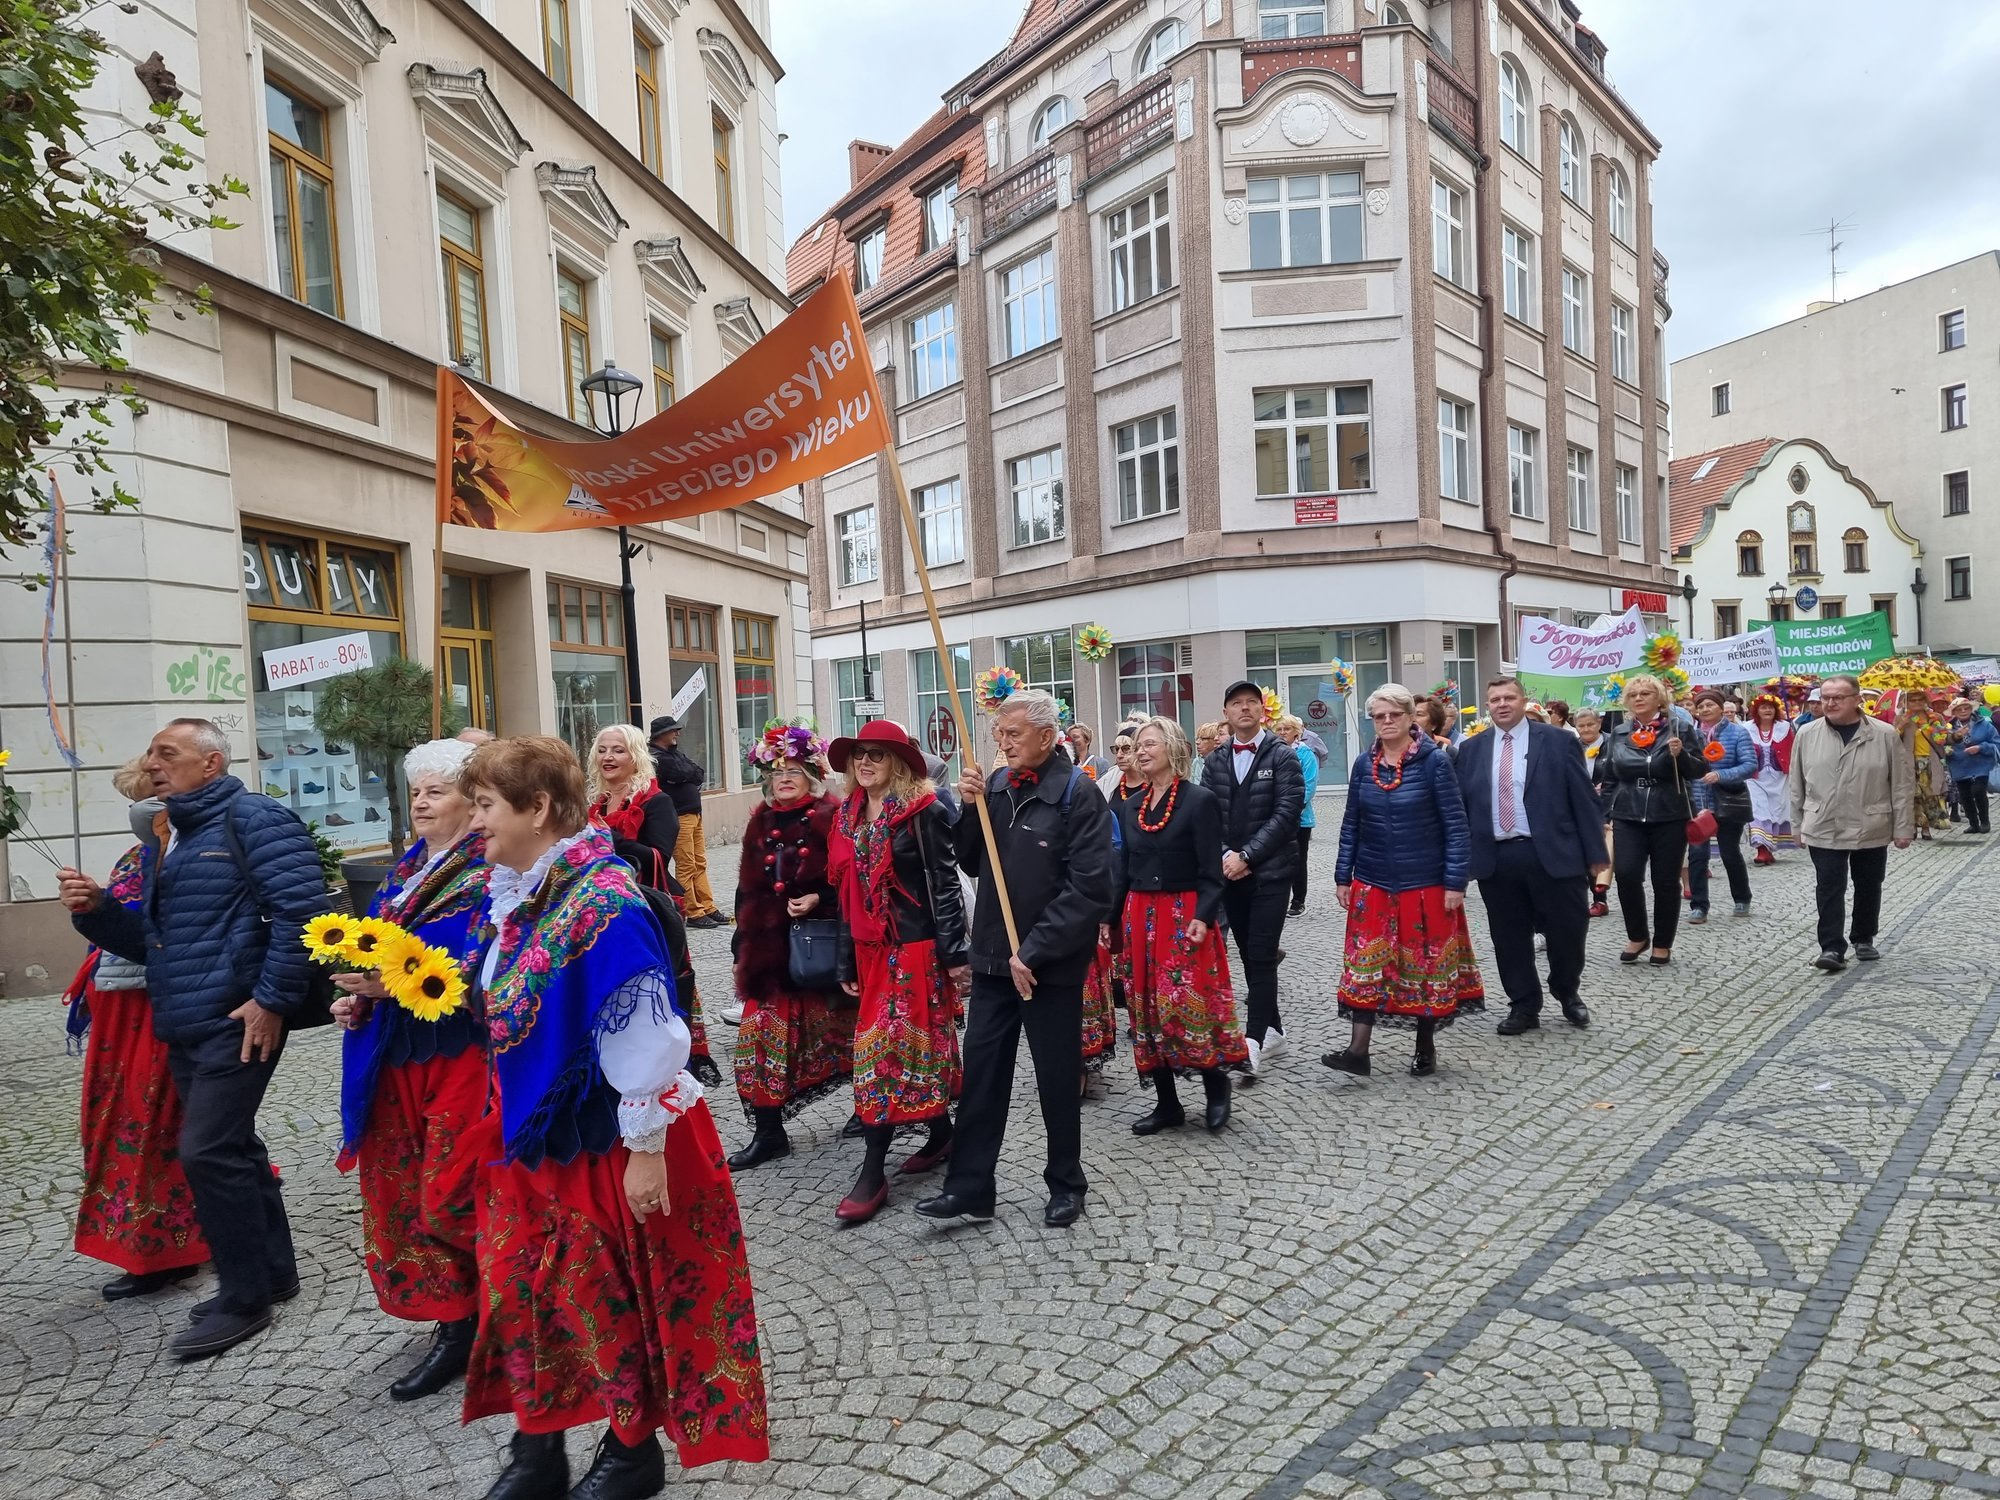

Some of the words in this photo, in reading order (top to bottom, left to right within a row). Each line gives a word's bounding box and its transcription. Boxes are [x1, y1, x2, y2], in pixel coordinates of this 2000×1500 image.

[649, 321, 855, 464] Uniwersytet
[781, 389, 872, 463] Wieku
[242, 550, 377, 604] BUTY
[1789, 624, 1847, 640] MIEJSKA
[1681, 646, 1704, 656] LSKI
[1804, 639, 1873, 657] SENIORÓW
[270, 656, 315, 681] RABAT
[317, 659, 330, 670] do
[332, 643, 368, 665] -80%
[1547, 645, 1624, 670] Wrzosy
[1678, 656, 1714, 666] RYTÓW
[1788, 658, 1867, 675] KOWARACH
[1687, 668, 1719, 677] LIDÓW
[1738, 659, 1773, 672] KOWARY
[1257, 769, 1273, 777] EA7
